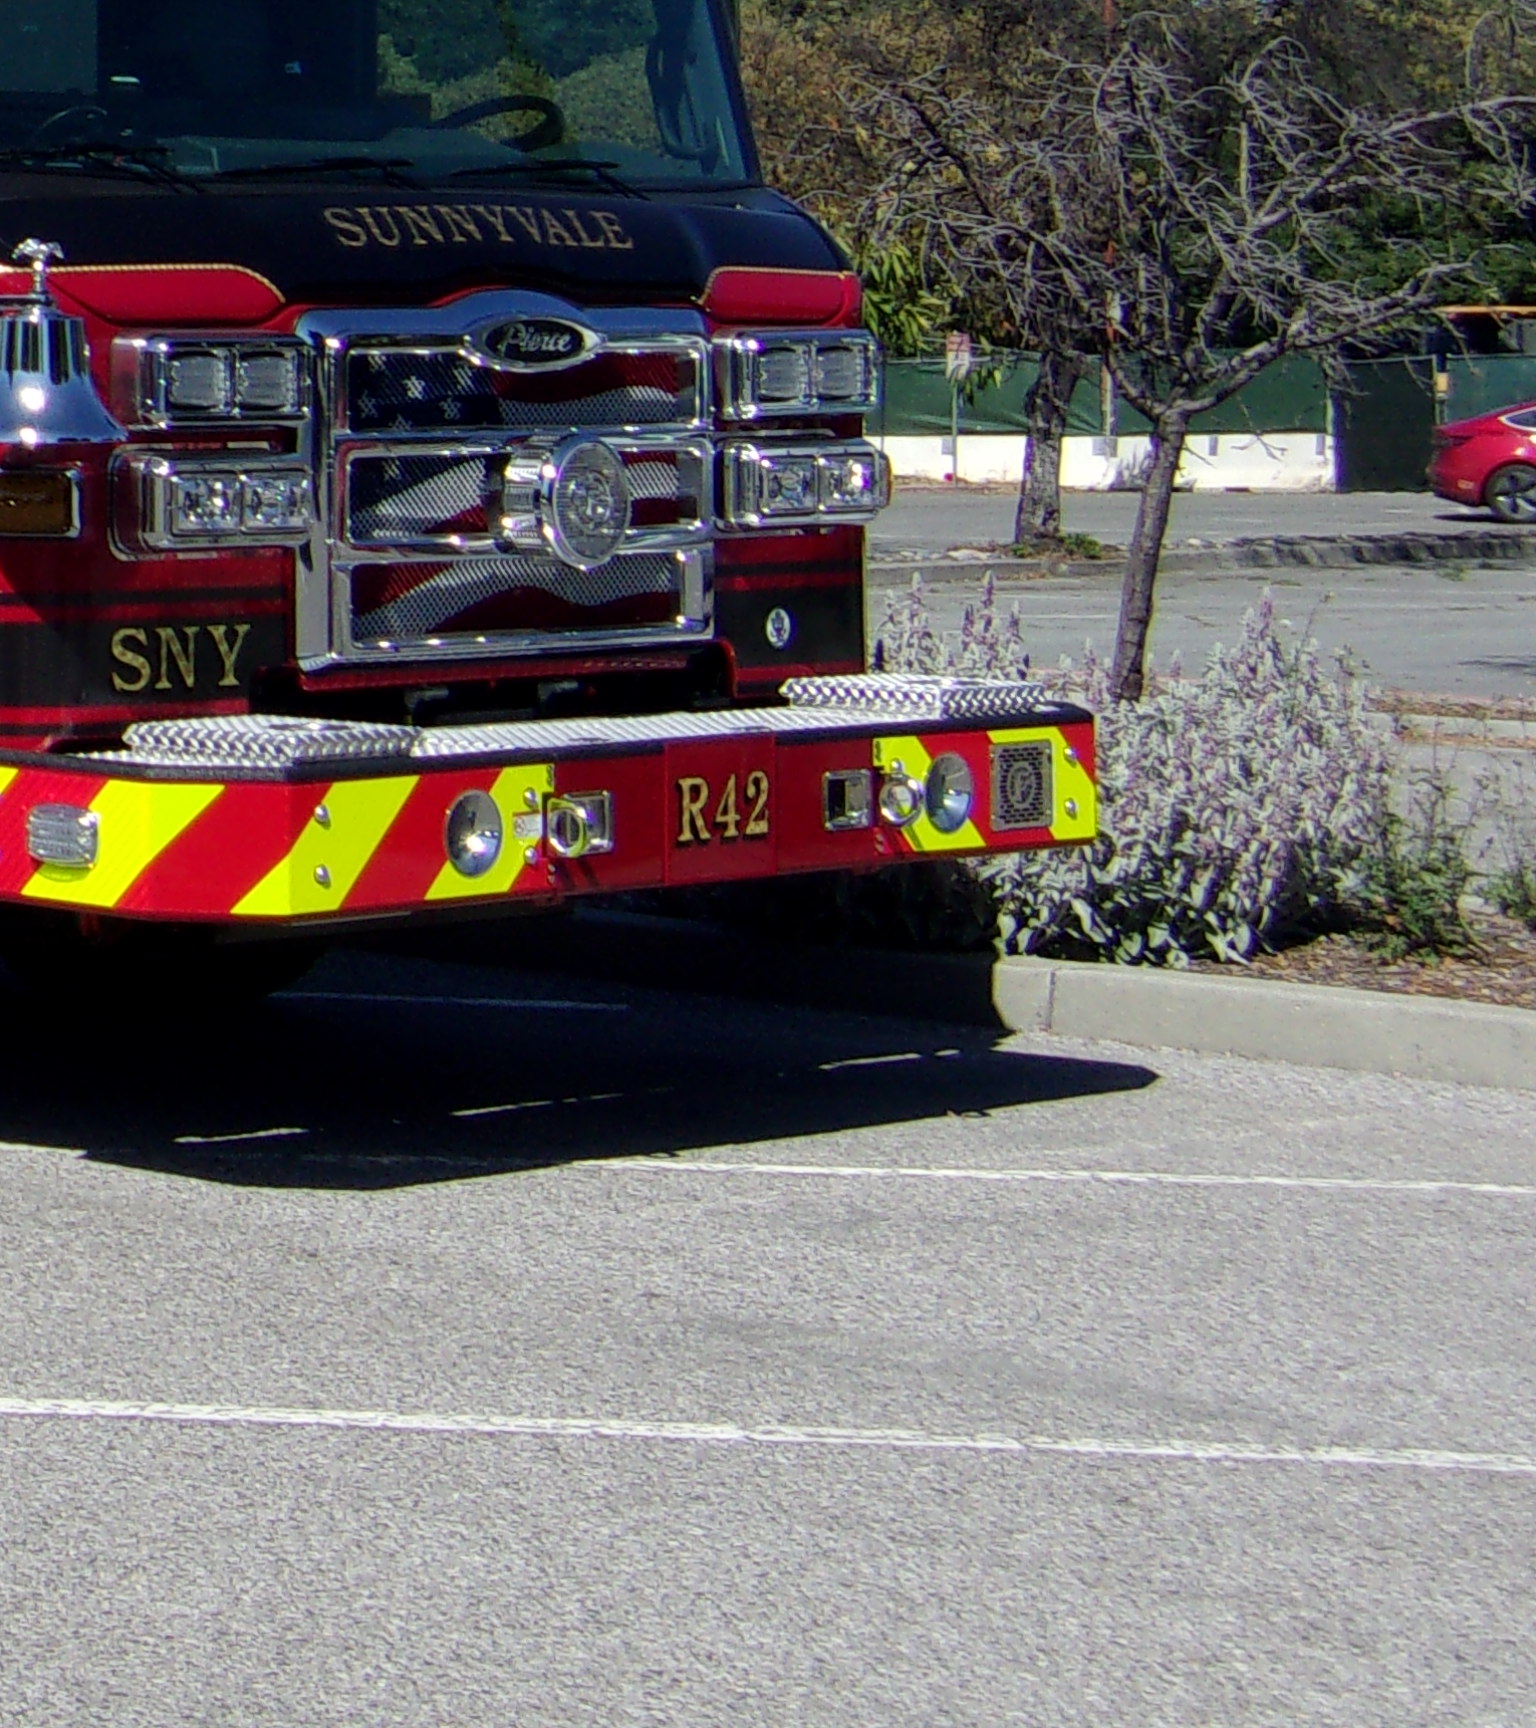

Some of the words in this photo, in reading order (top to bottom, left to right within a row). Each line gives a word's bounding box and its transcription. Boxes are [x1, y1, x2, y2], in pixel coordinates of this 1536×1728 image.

[323, 204, 634, 249] SUNNYVALE
[111, 623, 251, 692] SNY
[676, 770, 770, 842] R42
